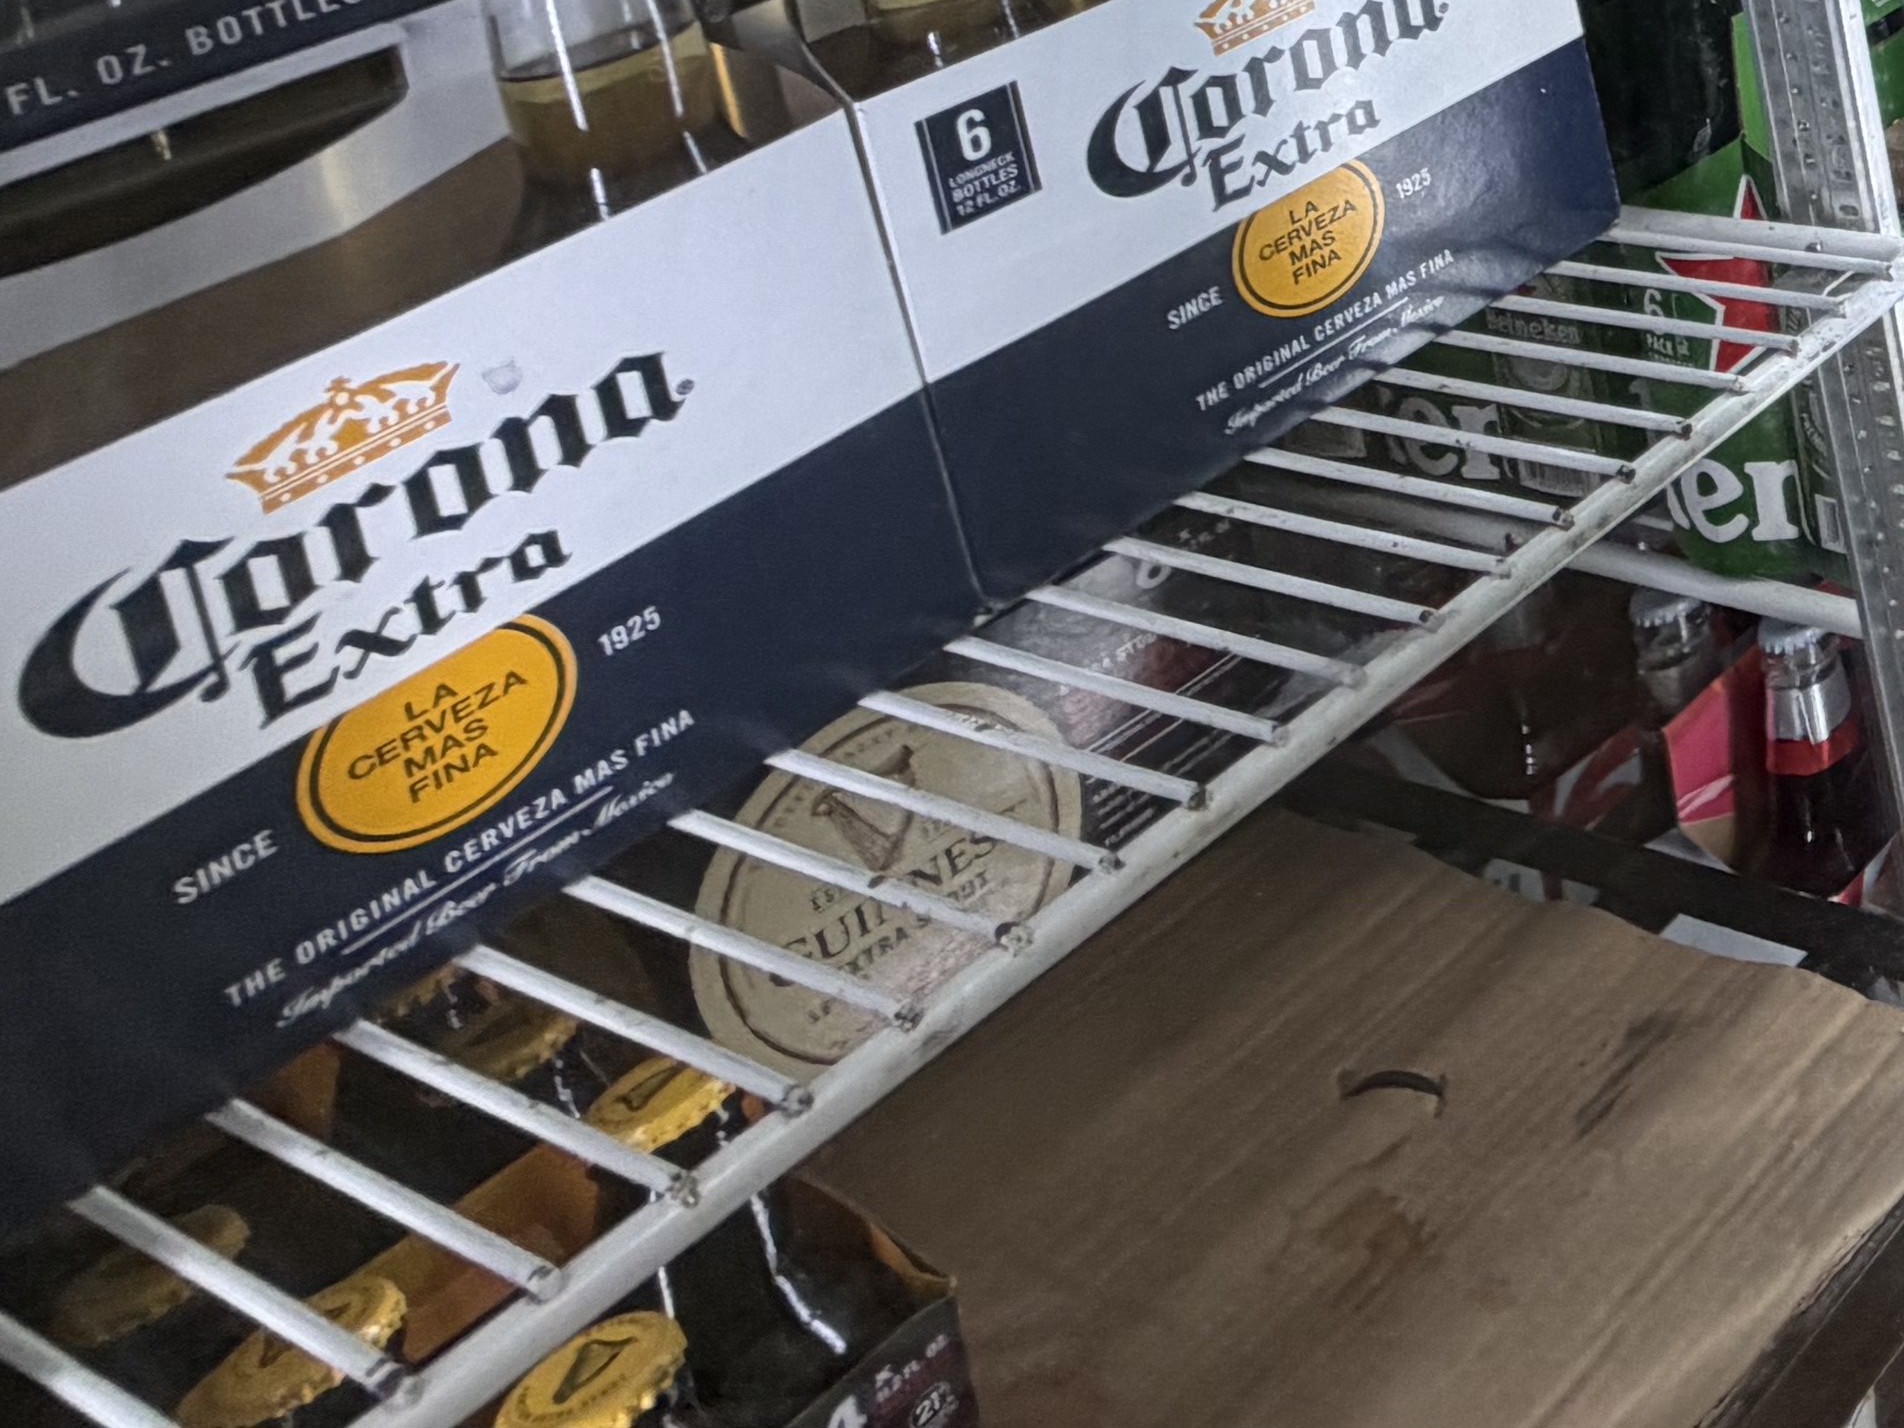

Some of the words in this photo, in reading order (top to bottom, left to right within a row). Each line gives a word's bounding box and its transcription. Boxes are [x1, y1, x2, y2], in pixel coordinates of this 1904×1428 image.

[5, 78, 80, 116] FL.
[97, 40, 172, 85] OZ.
[956, 109, 993, 162] 6
[1210, 97, 1381, 214] Extra
[947, 151, 1016, 190] LONGNECK
[951, 162, 1019, 203] BOTTLES
[1396, 166, 1433, 199] 1925
[954, 193, 977, 216] 12
[1258, 197, 1358, 261] CERVEZA
[1288, 199, 1317, 228] LA
[1288, 230, 1336, 269] MAS
[1291, 246, 1343, 287] FINA
[1167, 285, 1224, 332] SINCE
[1196, 381, 1227, 411] THE
[1231, 330, 1311, 392] ORIGINAL
[1313, 292, 1383, 345] CERVEZA
[1385, 268, 1418, 302] MAS
[1420, 248, 1455, 285] FINA
[16, 350, 695, 739] Corona
[247, 528, 572, 730] Extra
[597, 604, 663, 658] 1925
[346, 669, 529, 783] CERVEZA
[402, 679, 457, 724] LA
[401, 716, 492, 774] MAS
[408, 740, 499, 807] FINA
[170, 829, 280, 904] SINCE
[224, 968, 285, 1011] THE
[294, 869, 437, 971] ORIGINAL
[443, 795, 570, 872] CERVEZA
[572, 753, 628, 801] MAS
[631, 707, 697, 769] FINA
